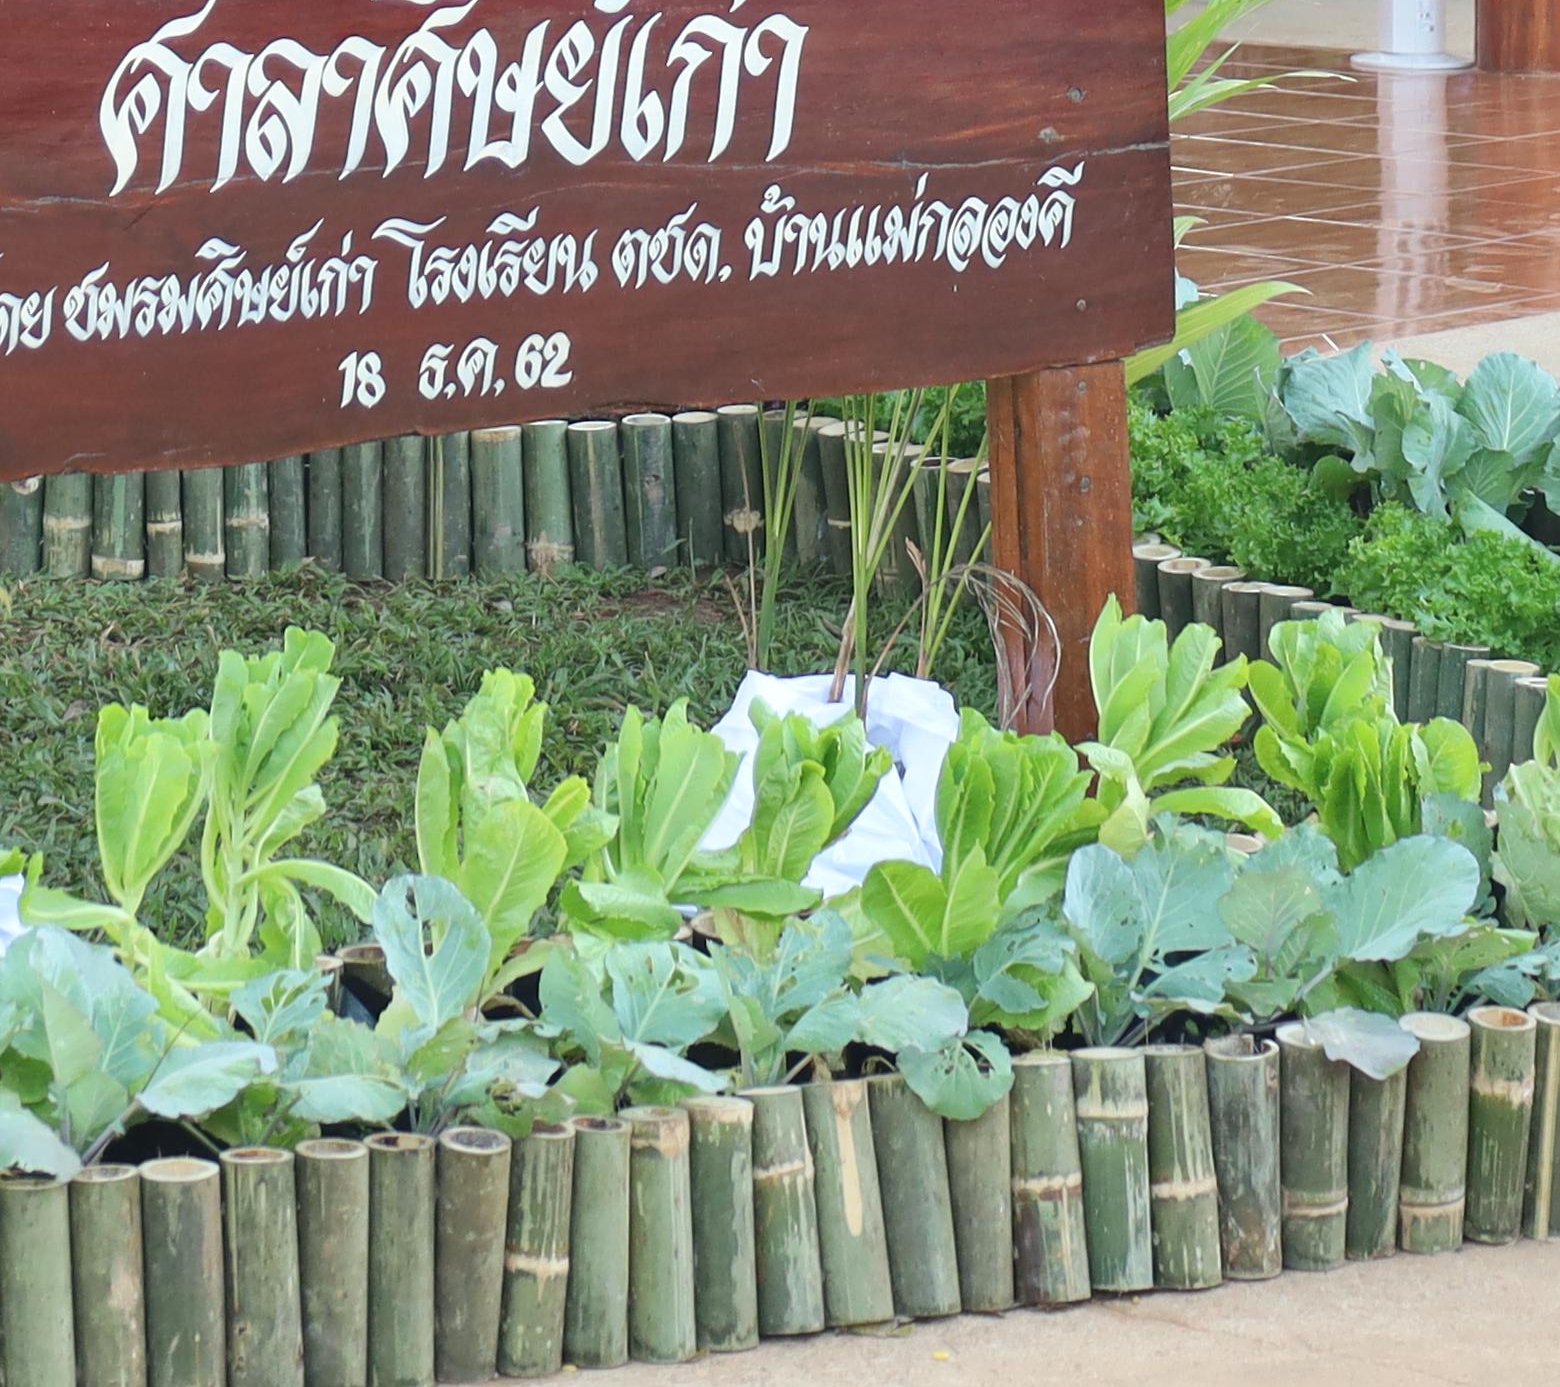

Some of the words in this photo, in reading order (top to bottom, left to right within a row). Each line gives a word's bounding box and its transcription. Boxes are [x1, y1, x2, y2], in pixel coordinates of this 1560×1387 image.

[63, 217, 378, 342] ชมรมศิษย์เก่า
[372, 206, 600, 309] โรงเรียน
[743, 162, 1086, 282] บ้านแม่กลองคี
[337, 350, 387, 409] 18
[514, 331, 574, 390] 62
